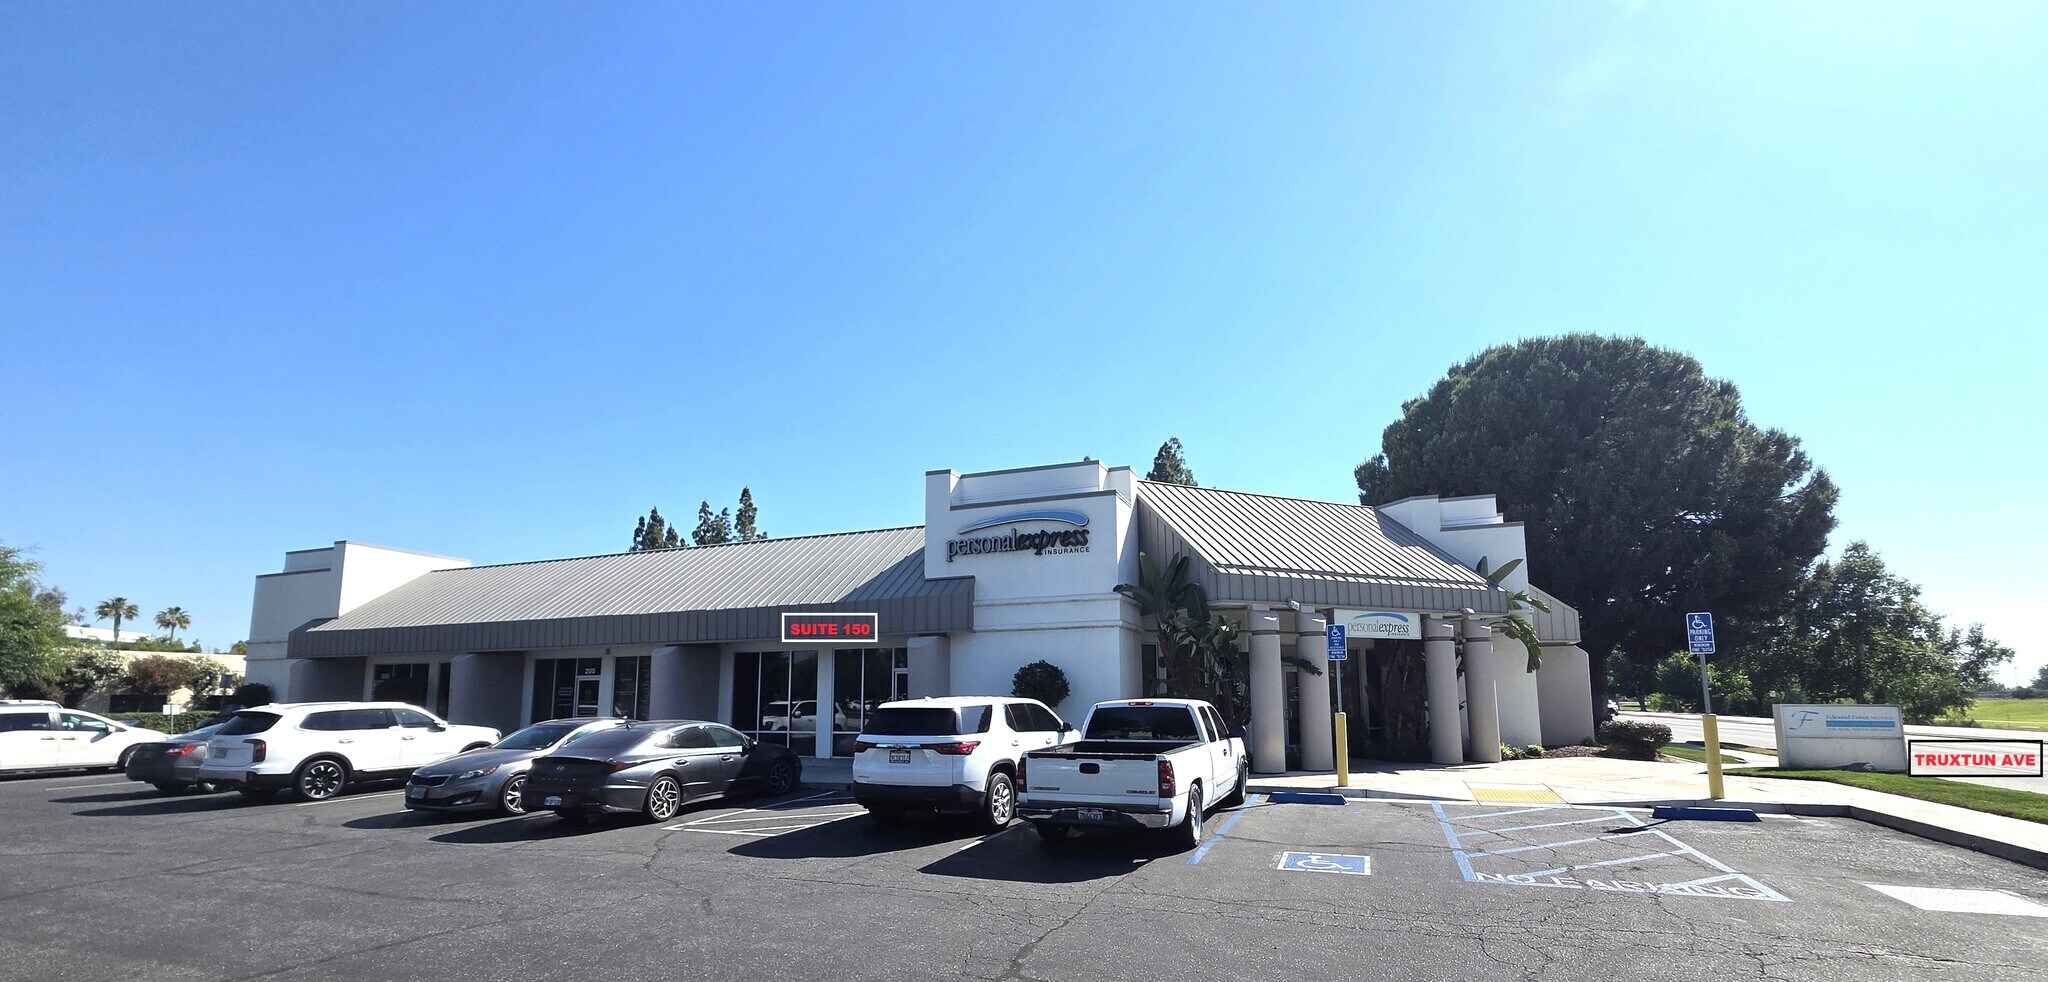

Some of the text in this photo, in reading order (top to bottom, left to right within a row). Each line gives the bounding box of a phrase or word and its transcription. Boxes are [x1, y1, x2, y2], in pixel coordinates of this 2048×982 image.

[946, 528, 1090, 562] personalexpress
[1044, 547, 1090, 555] INSURANCE
[1347, 620, 1410, 636] personalexpress
[584, 667, 596, 675] 200
[1476, 871, 1537, 884] NO
